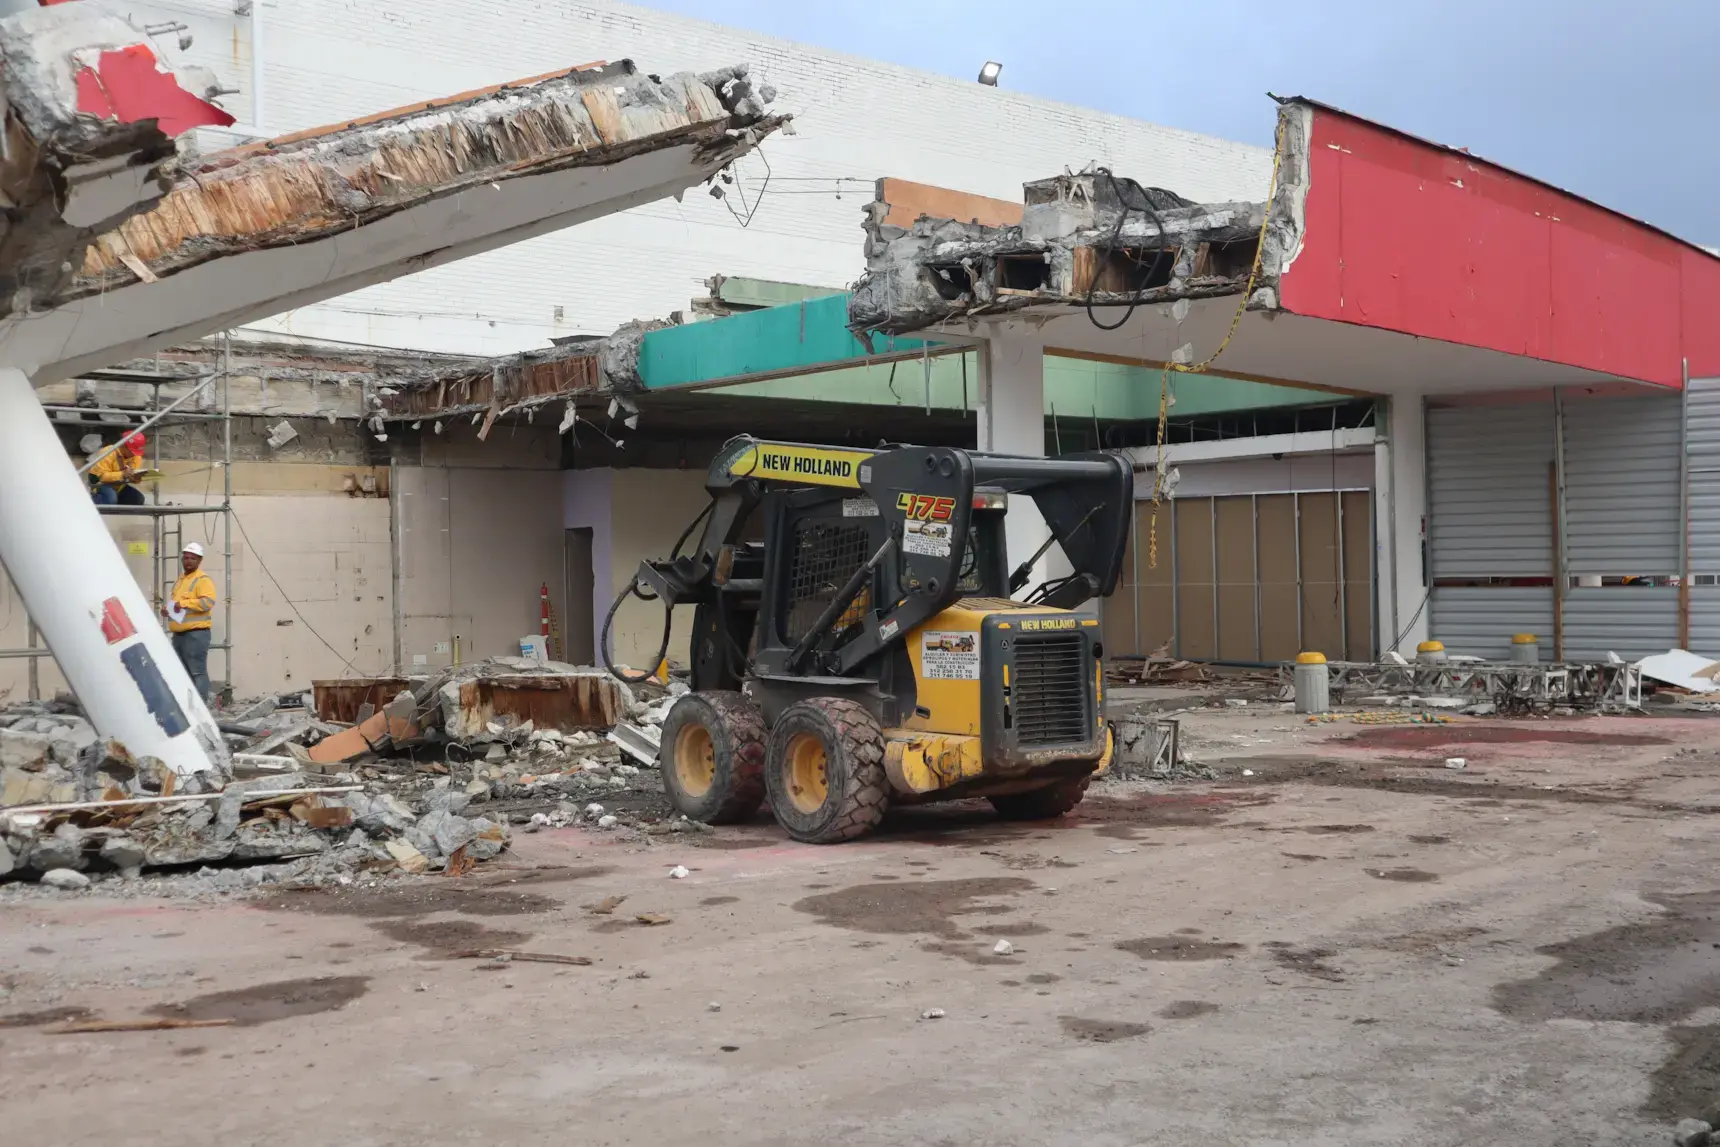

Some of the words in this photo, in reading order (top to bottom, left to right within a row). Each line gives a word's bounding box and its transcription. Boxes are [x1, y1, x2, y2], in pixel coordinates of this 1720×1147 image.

[763, 453, 791, 472] NEW
[794, 456, 851, 478] HOLLAND
[897, 493, 955, 519] L175
[1021, 620, 1040, 631] NEW
[1041, 619, 1076, 630] HOLLAND
